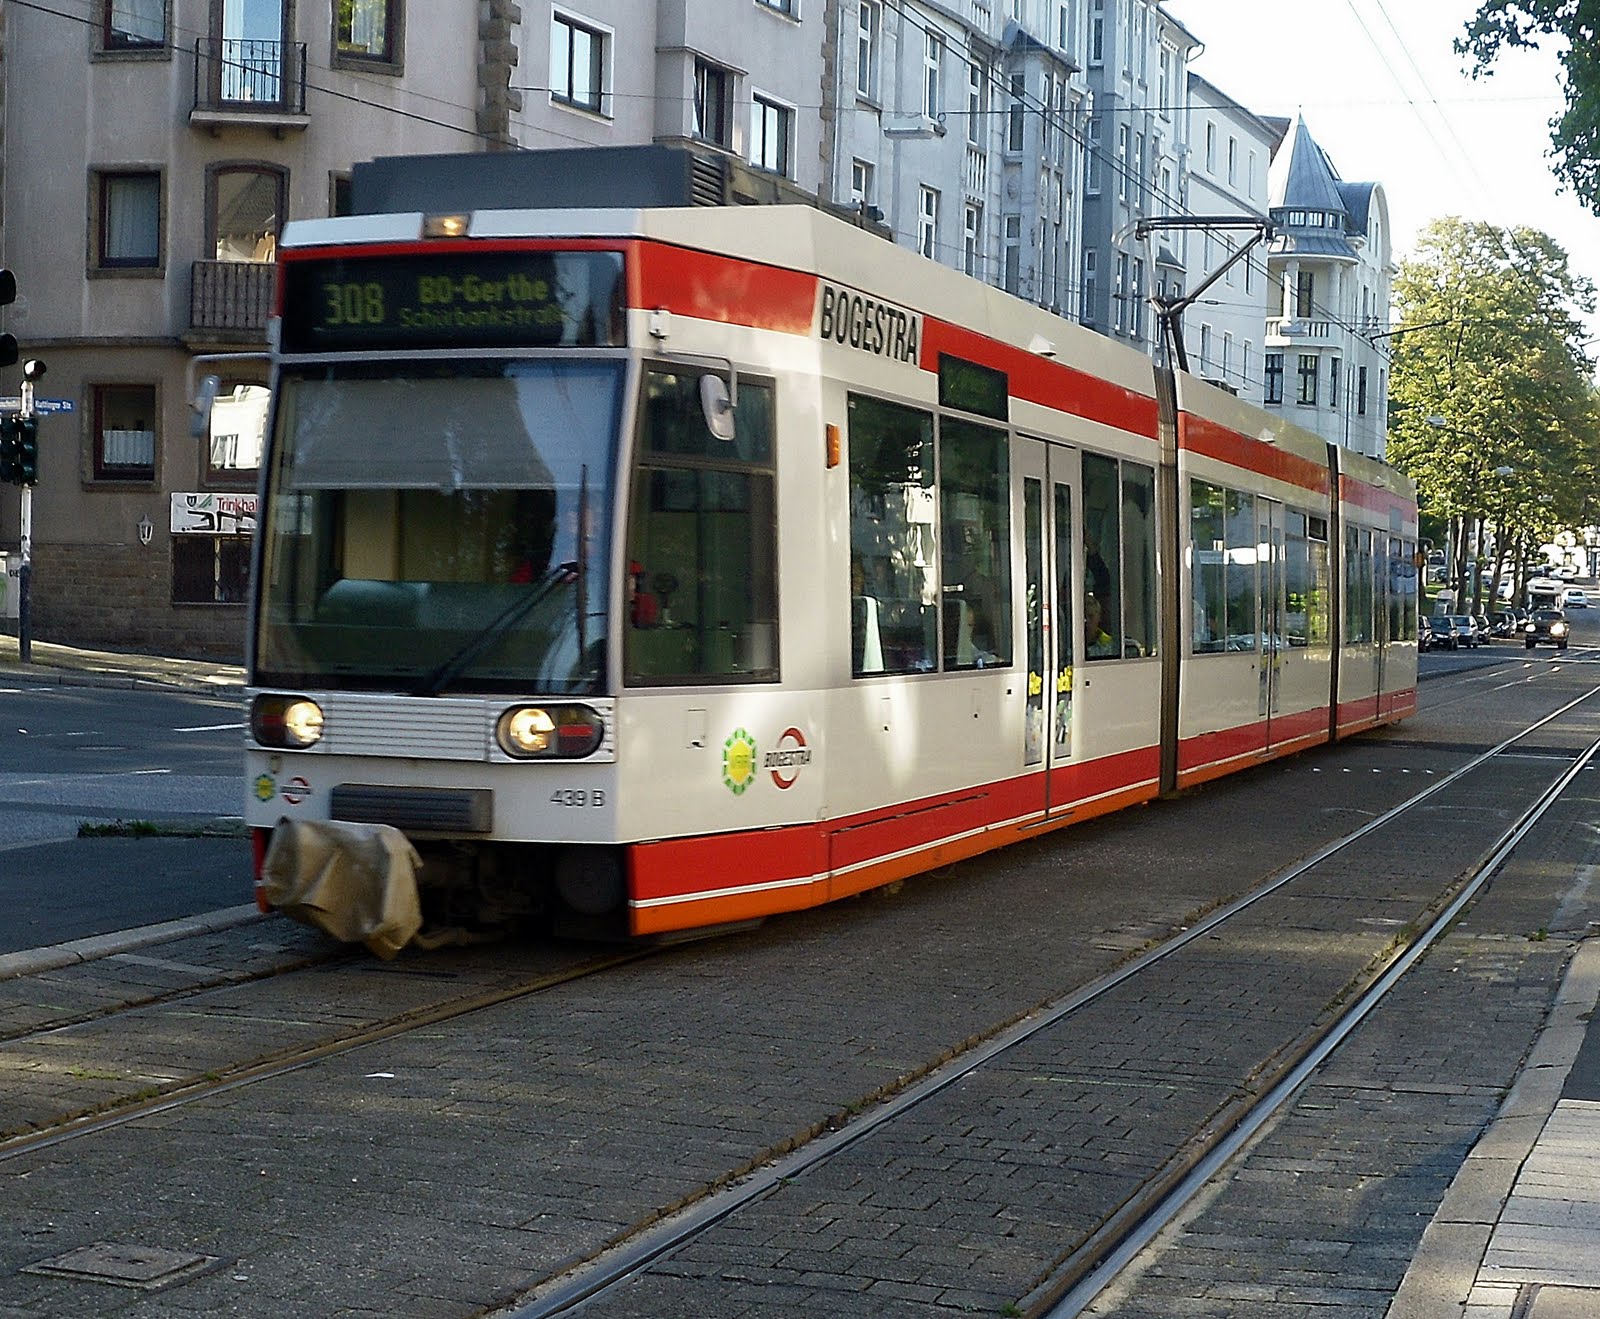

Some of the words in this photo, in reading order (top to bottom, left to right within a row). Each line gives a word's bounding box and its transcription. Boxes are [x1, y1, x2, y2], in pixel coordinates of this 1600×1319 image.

[321, 282, 385, 325] 308
[417, 273, 550, 304] BO-Gerthe
[820, 284, 919, 366] BOGESTRA
[550, 790, 587, 807] 439
[592, 790, 606, 807] B
